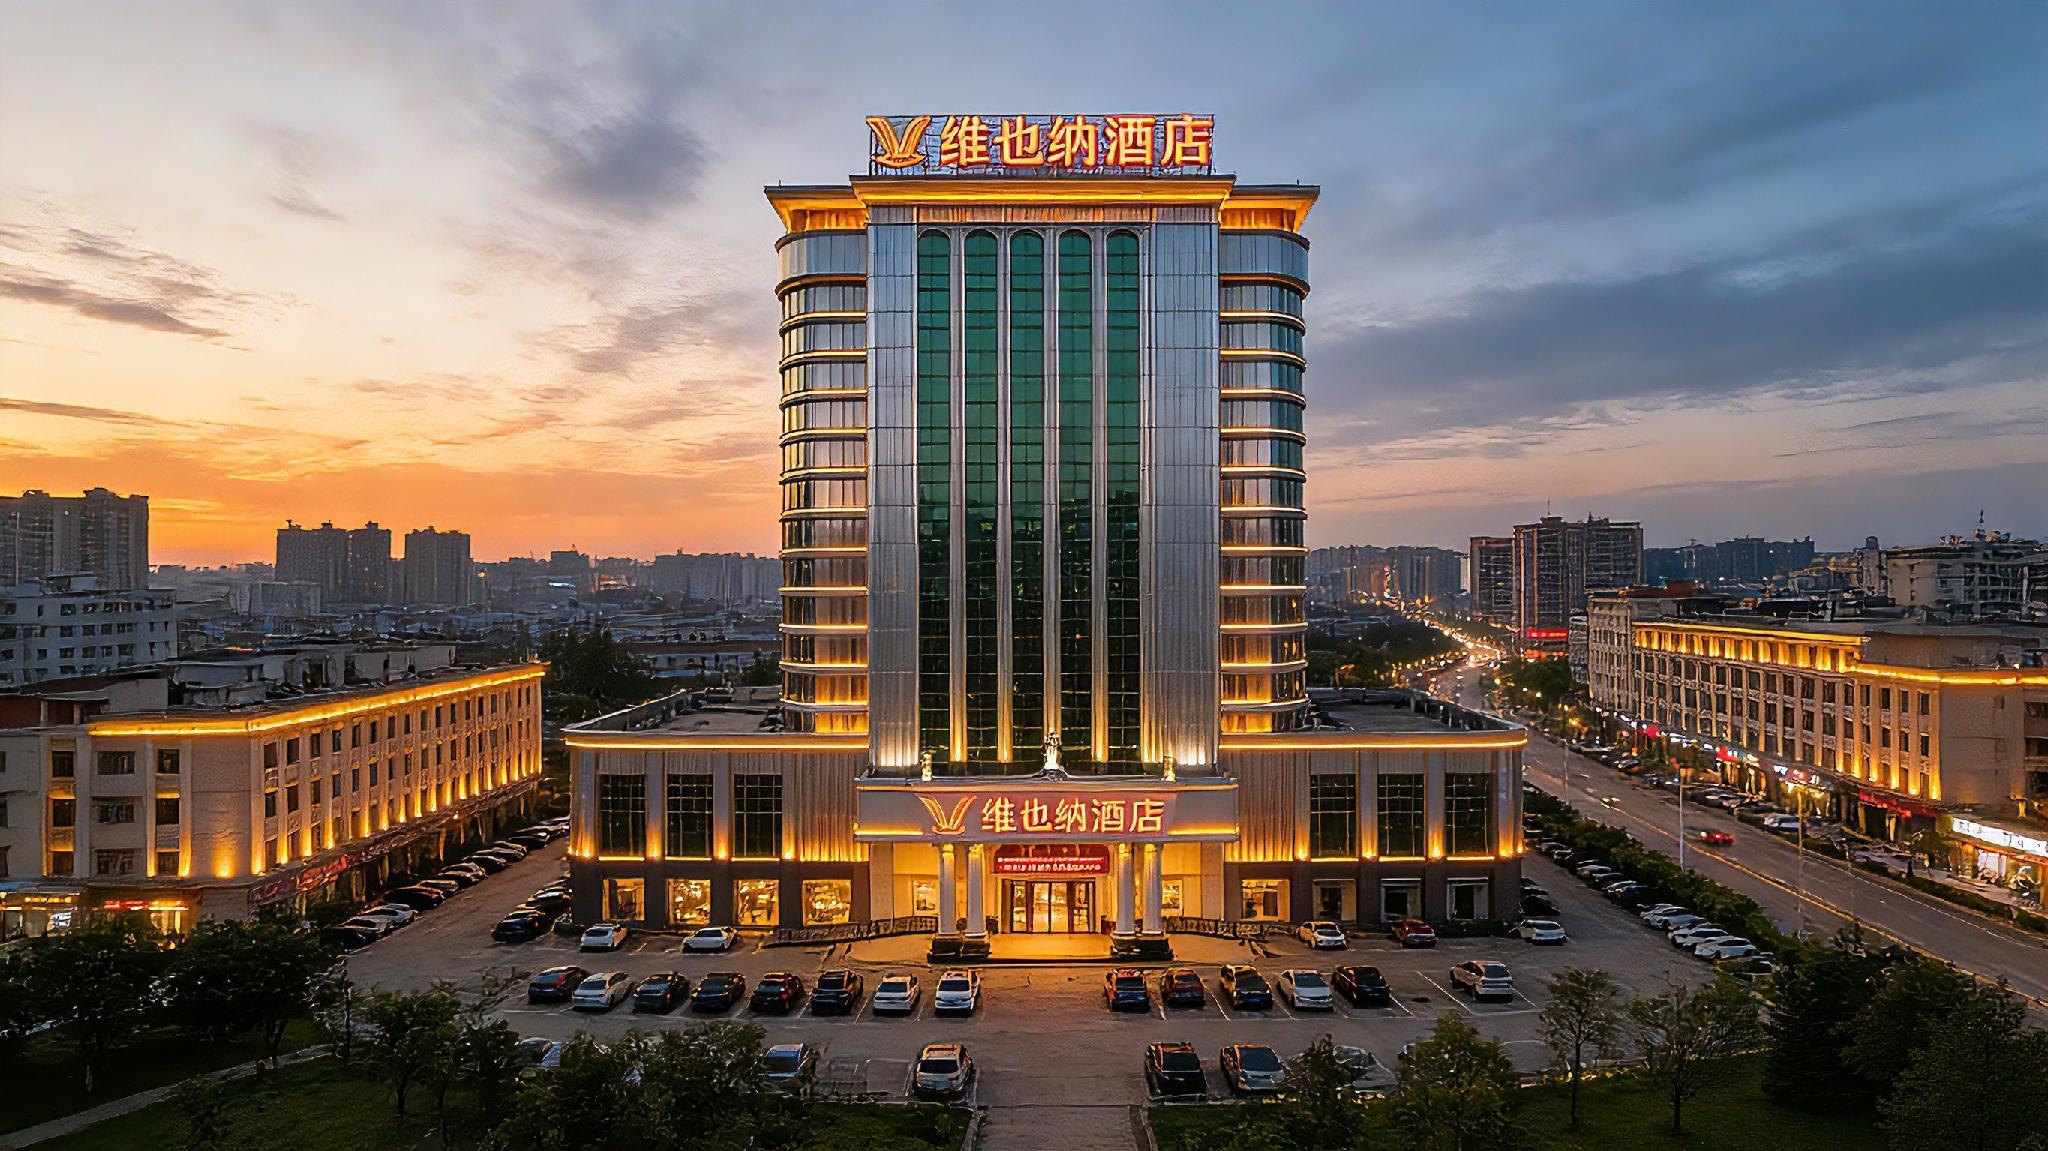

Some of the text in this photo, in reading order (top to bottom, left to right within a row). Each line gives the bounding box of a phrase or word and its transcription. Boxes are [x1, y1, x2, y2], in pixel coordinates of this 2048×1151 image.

[940, 114, 1212, 168] 维也纳酒店
[981, 797, 1164, 833] 维也纳酒店
